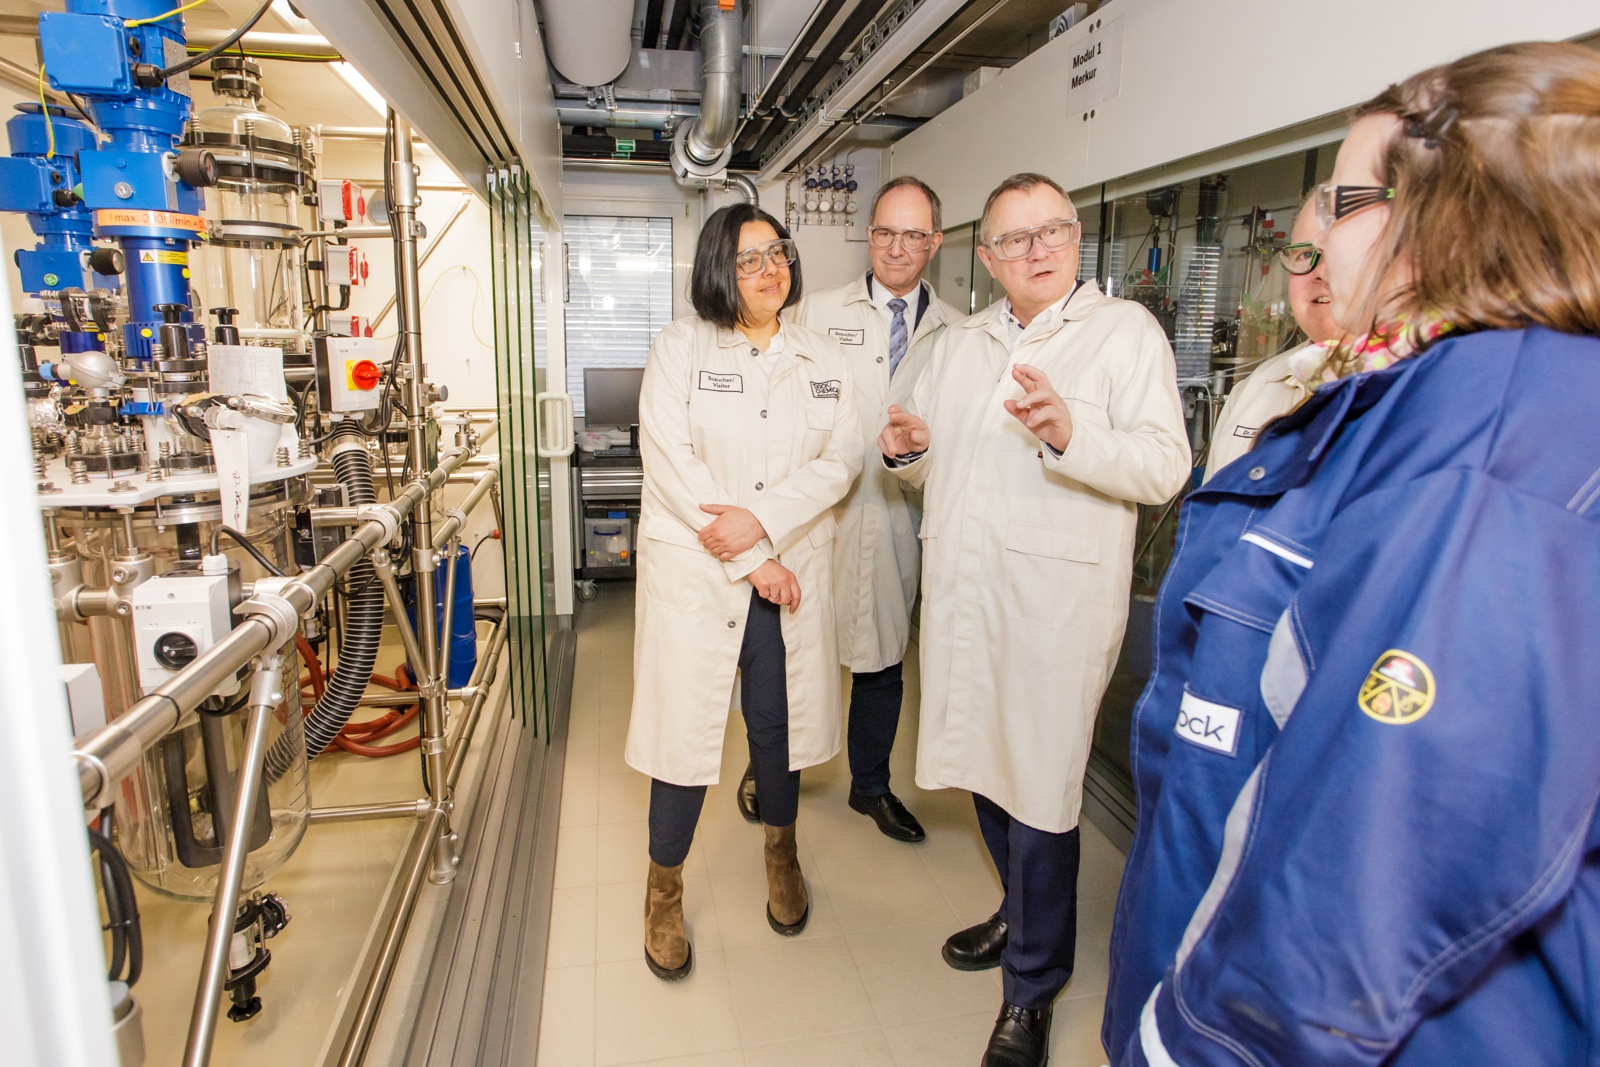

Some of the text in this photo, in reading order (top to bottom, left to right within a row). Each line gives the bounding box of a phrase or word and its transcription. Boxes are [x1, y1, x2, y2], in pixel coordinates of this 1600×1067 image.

[1072, 42, 1101, 69] Modul 1
[1071, 68, 1097, 89] Merkur
